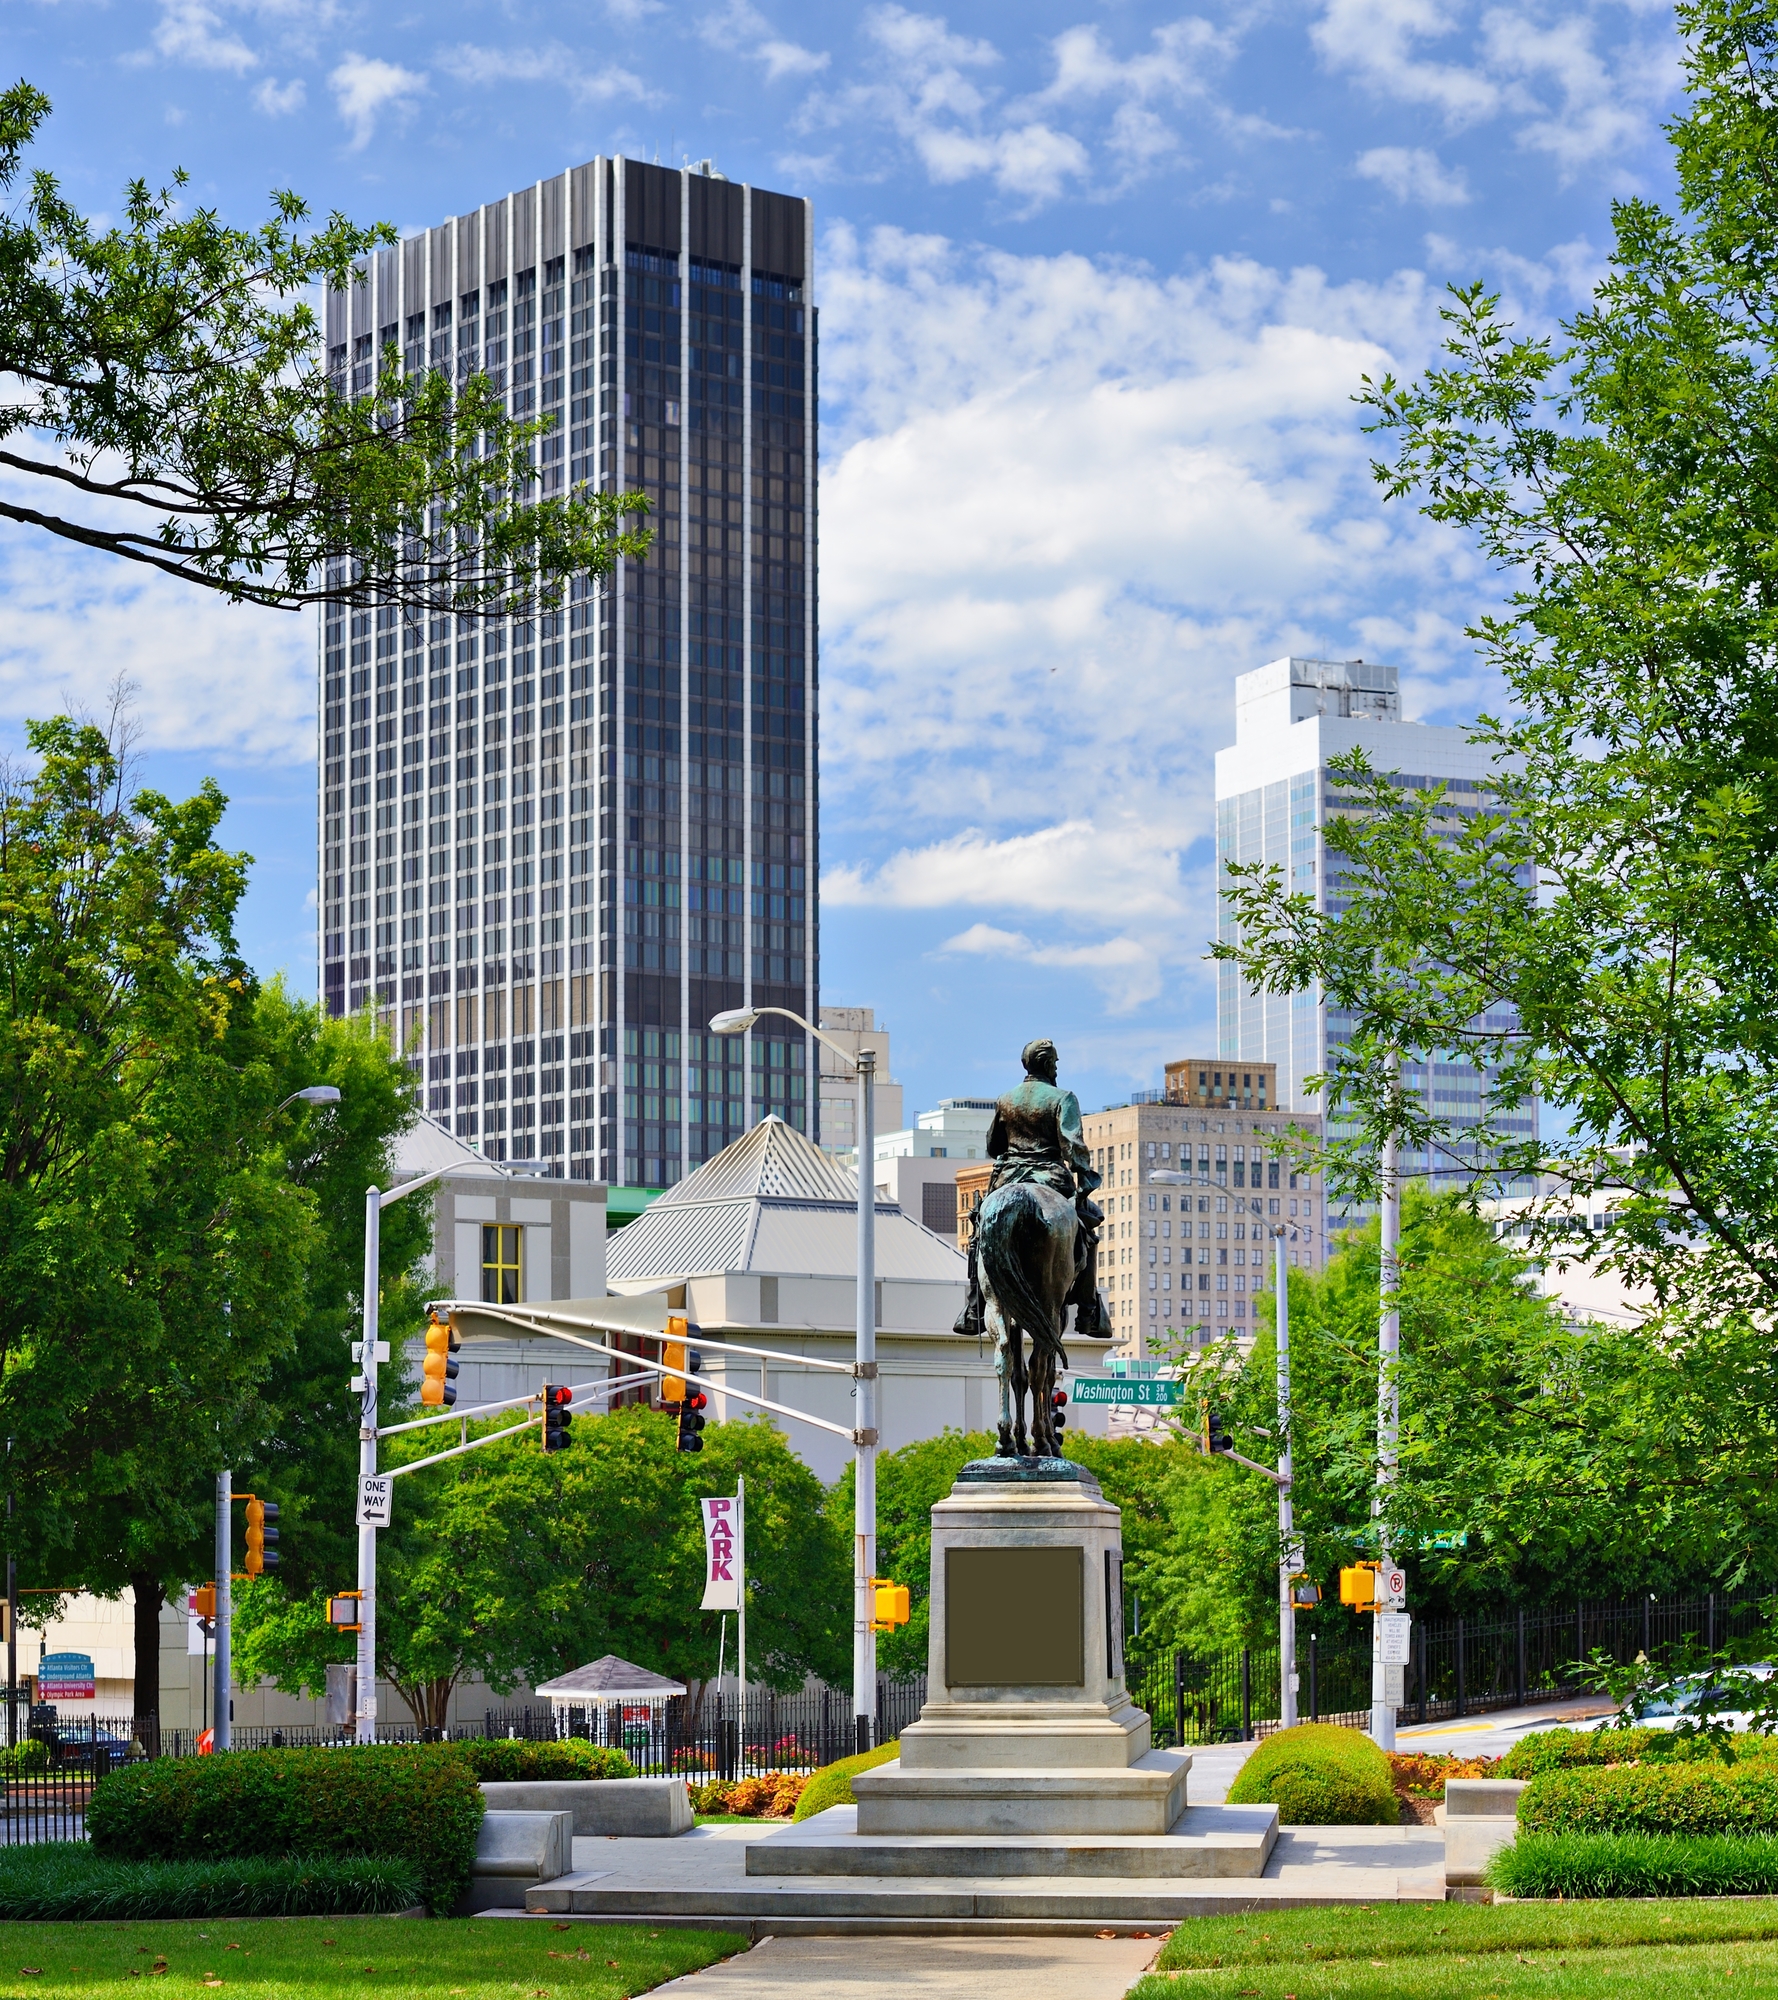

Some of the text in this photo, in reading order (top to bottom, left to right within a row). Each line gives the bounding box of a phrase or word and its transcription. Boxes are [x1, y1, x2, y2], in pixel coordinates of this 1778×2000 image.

[1156, 1384, 1165, 1392] SW
[1076, 1383, 1150, 1404] Washington St
[1156, 1393, 1167, 1401] 200
[365, 1480, 386, 1492] ONE
[364, 1495, 385, 1507] WAY
[709, 1499, 734, 1581] PARK
[47, 1673, 75, 1681] Underground
[64, 1682, 85, 1690] University
[46, 1691, 64, 1699] Olympic
